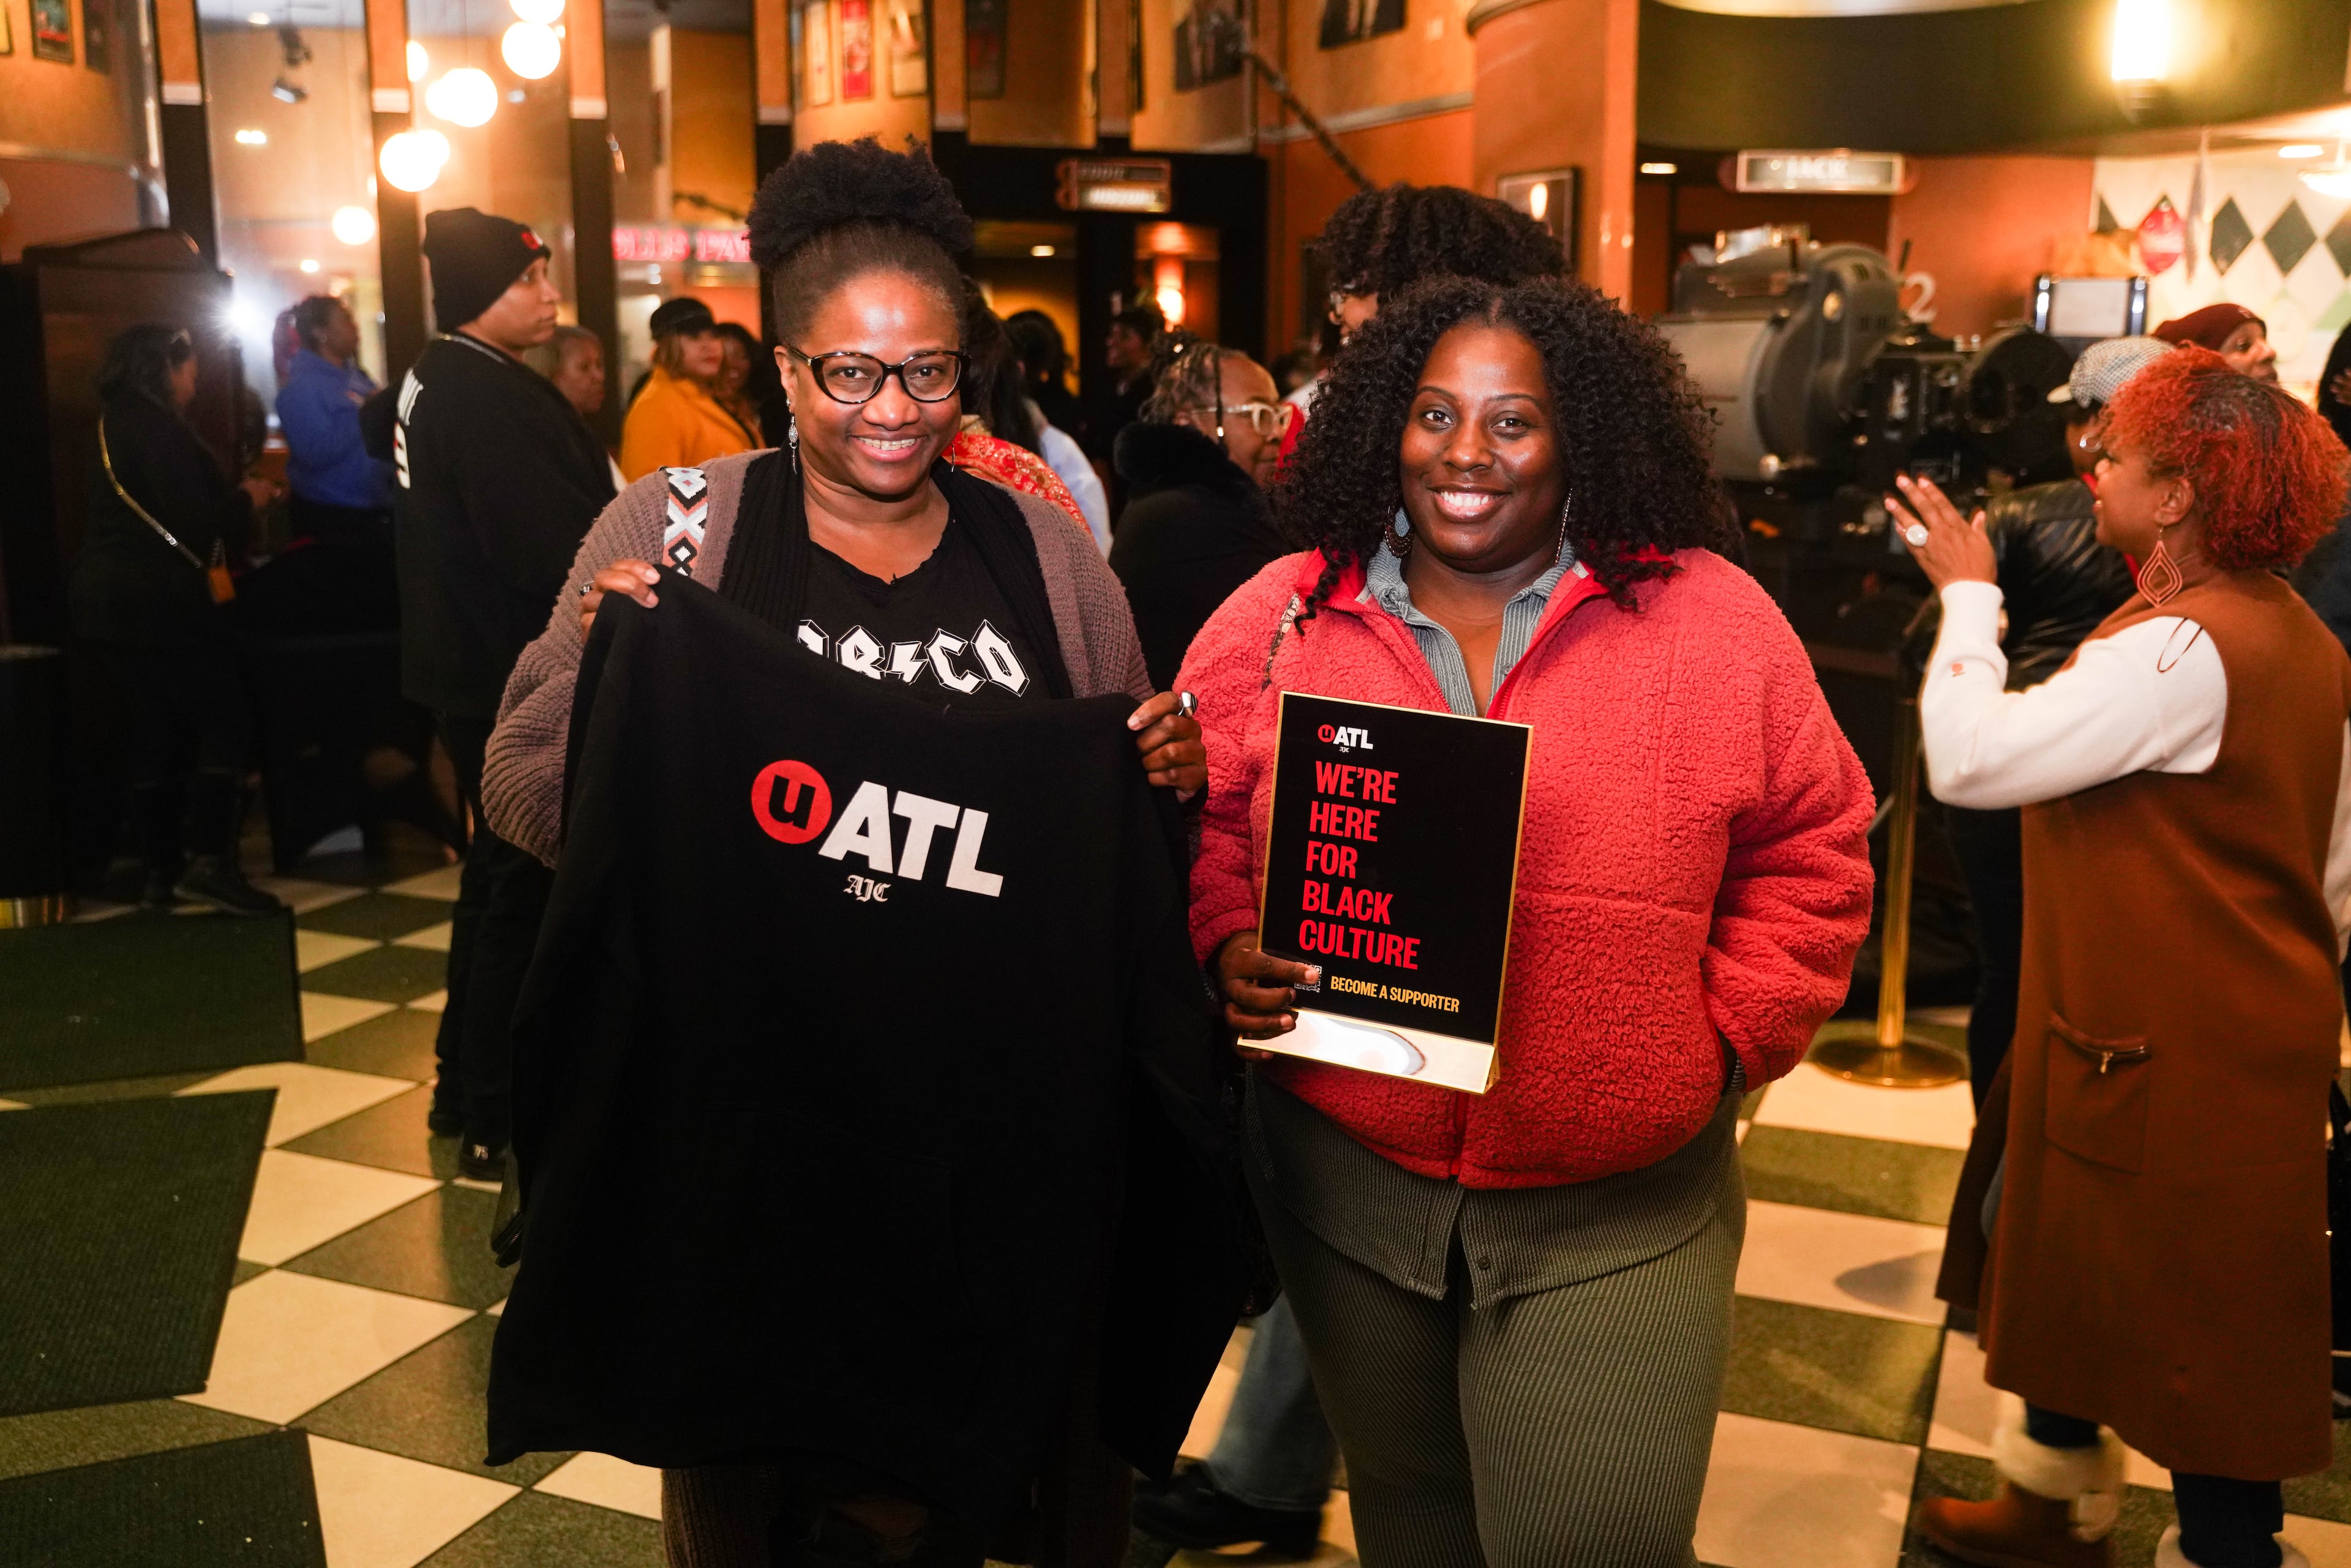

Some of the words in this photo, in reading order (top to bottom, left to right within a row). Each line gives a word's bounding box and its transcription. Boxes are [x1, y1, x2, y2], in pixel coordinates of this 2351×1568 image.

[1905, 272, 1937, 323] 2
[1315, 761, 1400, 805] WE'RE
[1309, 800, 1381, 842] HERE
[1305, 840, 1358, 879] FOR
[1302, 879, 1393, 925] BLACK
[1299, 919, 1421, 970] CULTURE
[1330, 976, 1378, 997] BECOME
[1379, 985, 1388, 1000] A
[1390, 986, 1460, 1013] SUPPORTER
